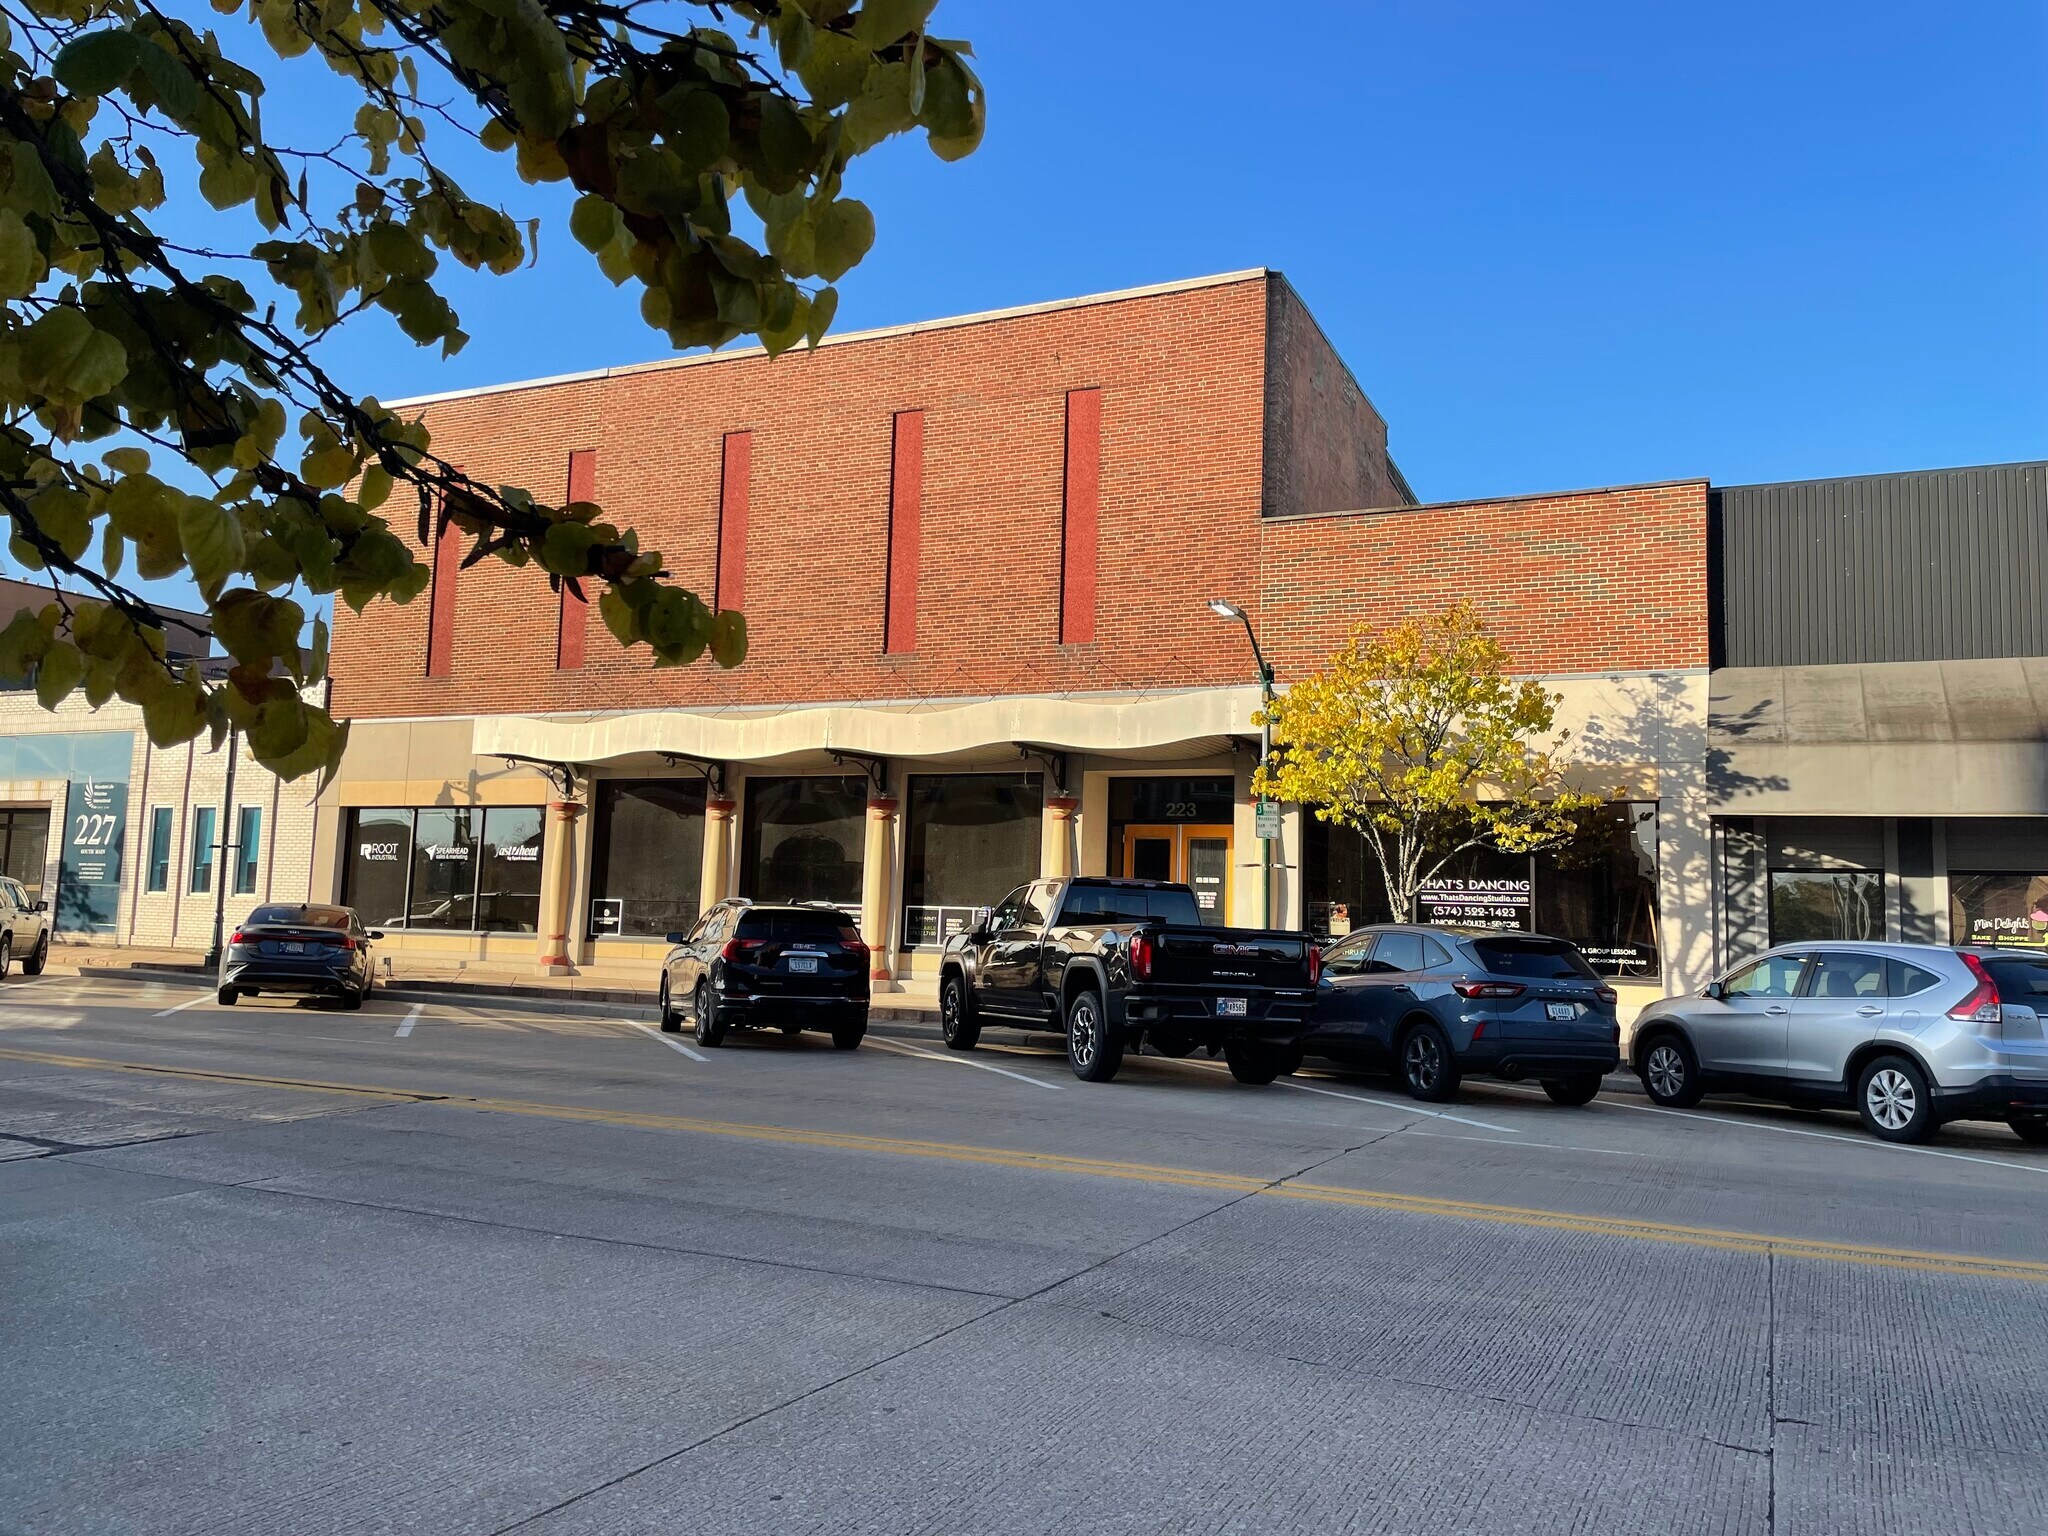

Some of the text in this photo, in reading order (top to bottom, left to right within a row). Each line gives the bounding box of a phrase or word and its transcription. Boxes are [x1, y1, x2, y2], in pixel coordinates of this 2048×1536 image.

[1166, 802, 1197, 817] 223
[1257, 804, 1262, 814] 3
[73, 813, 117, 846] 227
[371, 843, 399, 854] ROOT
[435, 847, 469, 855] SPEARHEAD
[1469, 880, 1531, 892] DANCING
[1420, 893, 1529, 904] www.ThatsDancingStudio.com
[1433, 906, 1516, 918] (574) 522-1423
[1461, 920, 1487, 928] ADULTS
[1973, 916, 2030, 934] Mini Delights
[1213, 943, 1259, 956] GMC
[1587, 947, 1610, 955] GROUP
[1610, 948, 1637, 956] LESSONS
